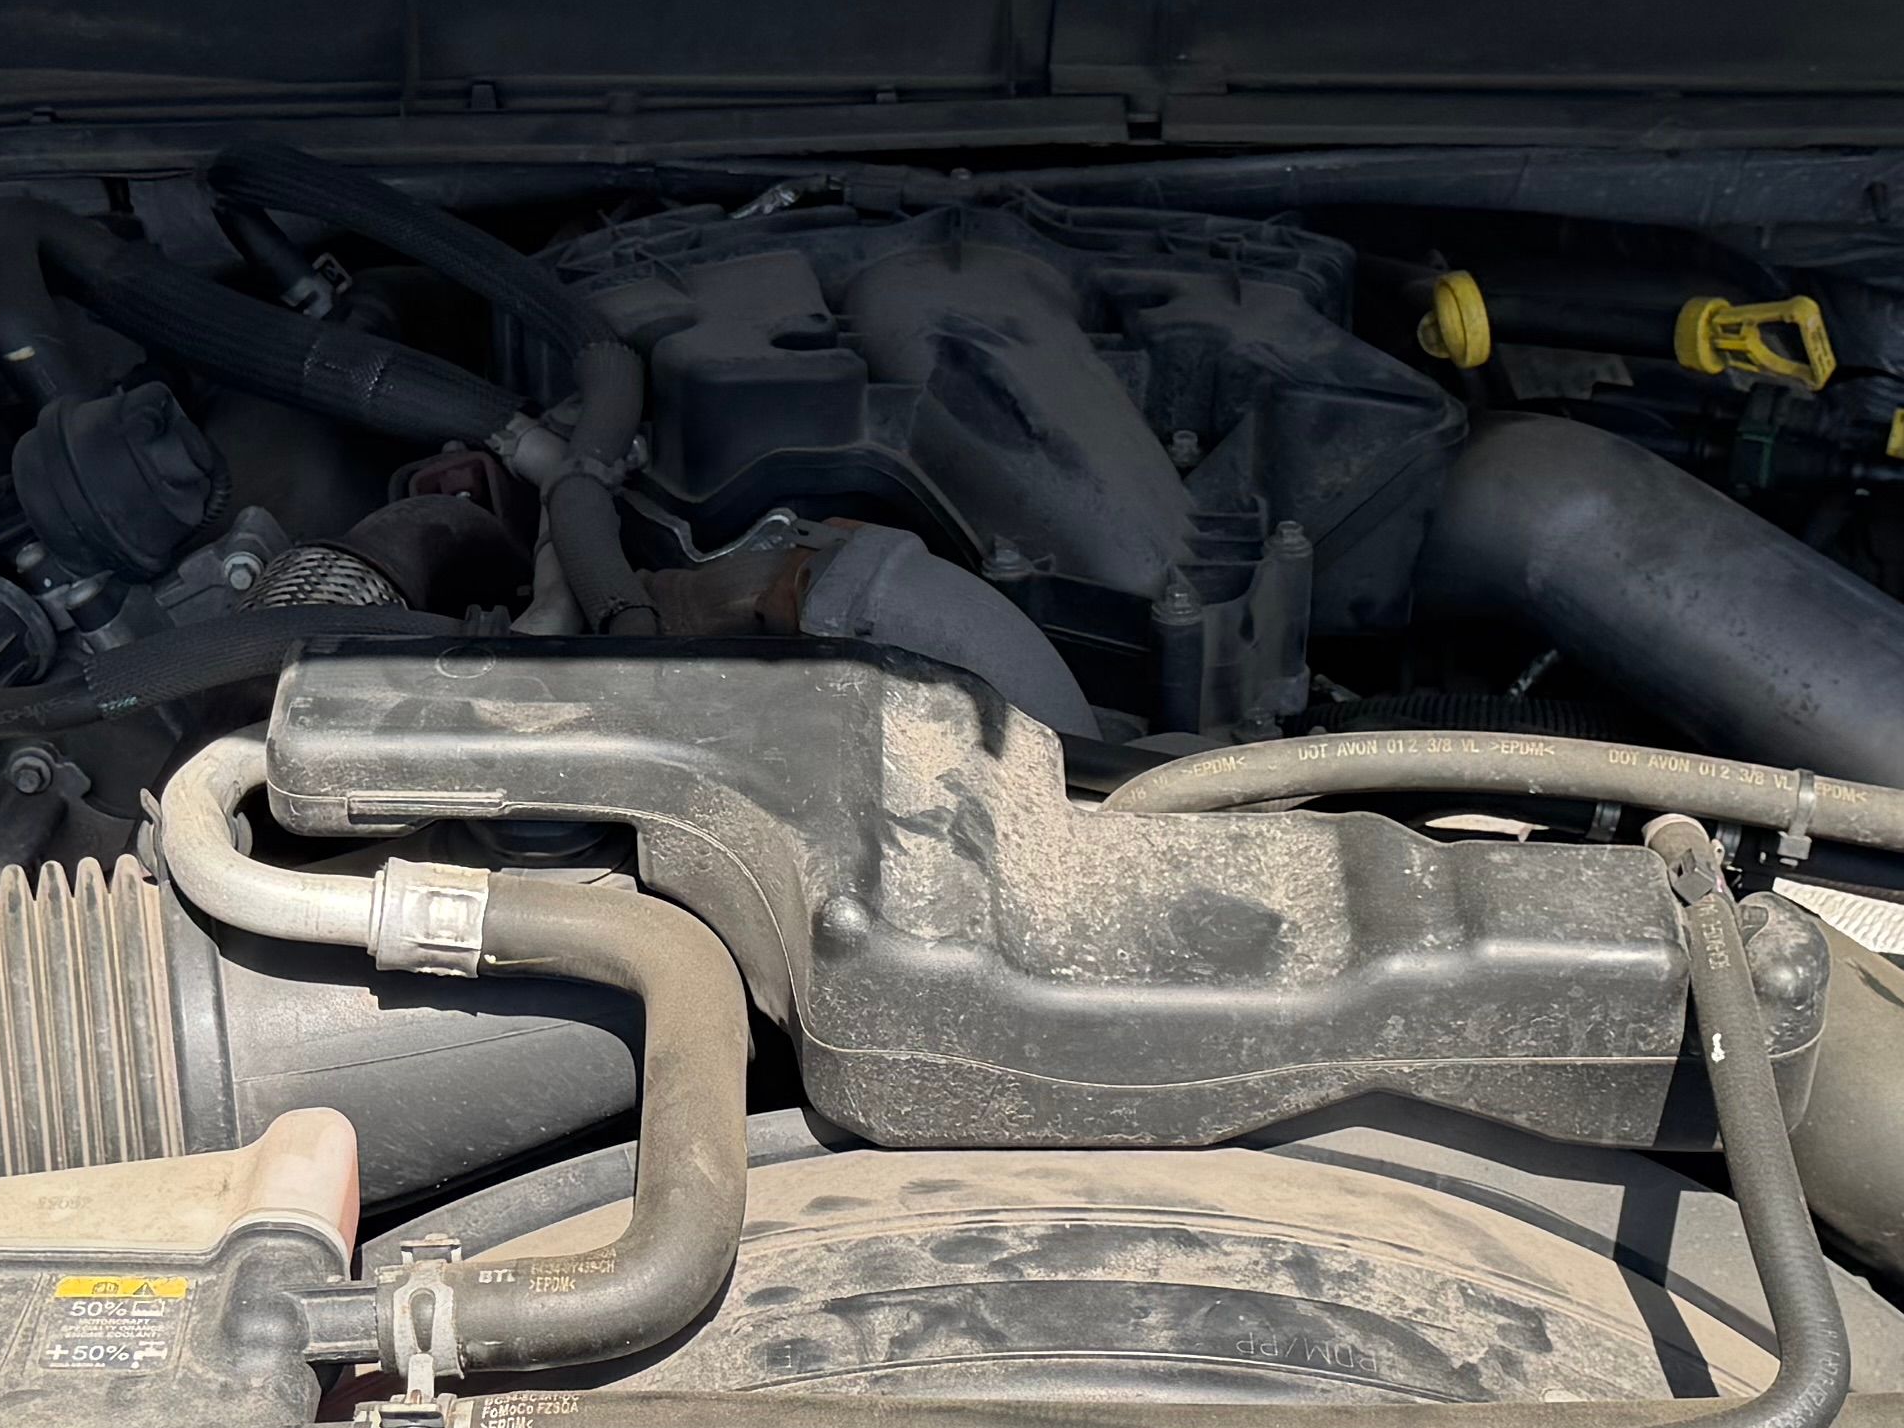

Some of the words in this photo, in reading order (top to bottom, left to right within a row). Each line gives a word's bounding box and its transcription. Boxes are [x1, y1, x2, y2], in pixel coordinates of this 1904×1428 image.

[1298, 744, 1328, 761] DOT
[1336, 740, 1377, 757] AVON
[1427, 739, 1451, 753] 3/8
[1608, 749, 1639, 766] DOT
[1648, 755, 1690, 773] AVON
[1739, 766, 1764, 785] 3/8
[1813, 781, 1868, 803] EPDM<
[529, 1276, 576, 1293] >EPDM<
[70, 1301, 127, 1317] 50%
[481, 1403, 534, 1419] FoMoCo
